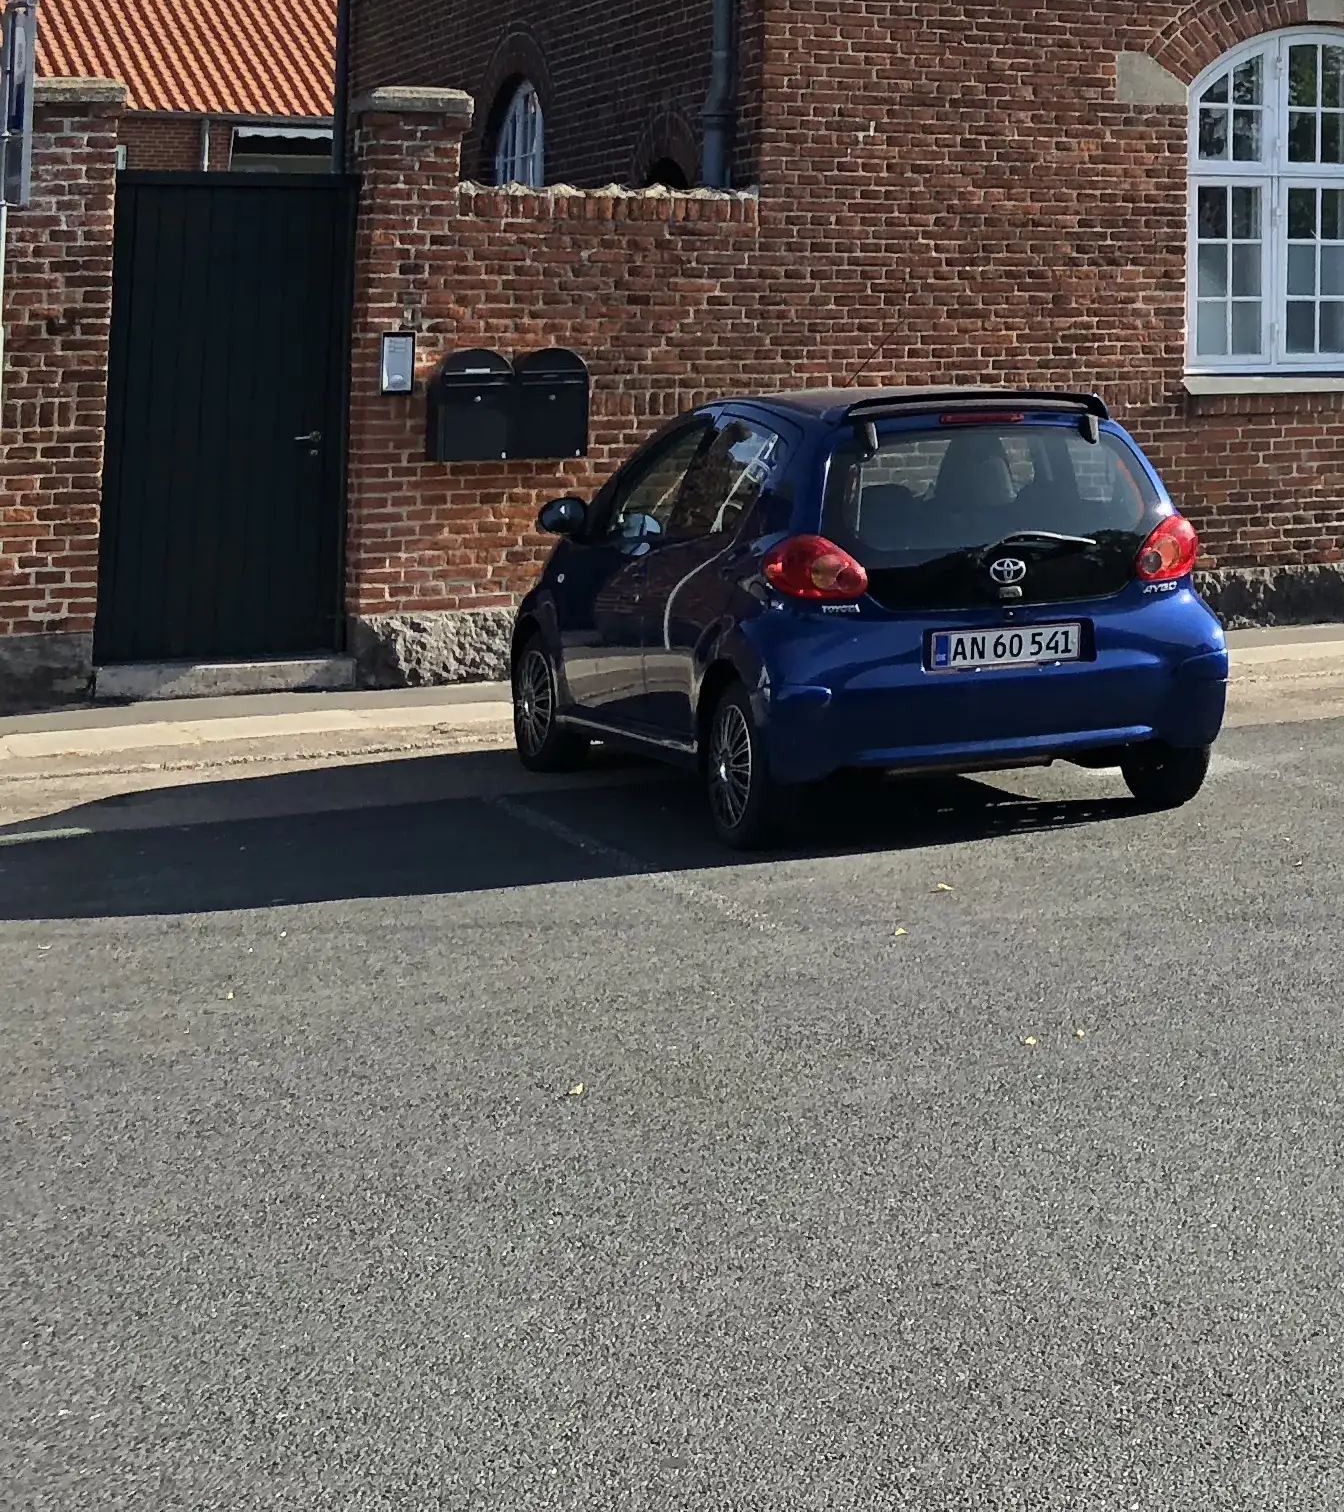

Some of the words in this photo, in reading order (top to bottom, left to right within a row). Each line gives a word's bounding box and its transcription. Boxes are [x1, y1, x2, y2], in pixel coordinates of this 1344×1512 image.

[951, 636, 986, 662] AN
[992, 633, 1023, 659] 60
[1029, 630, 1073, 657] 541
